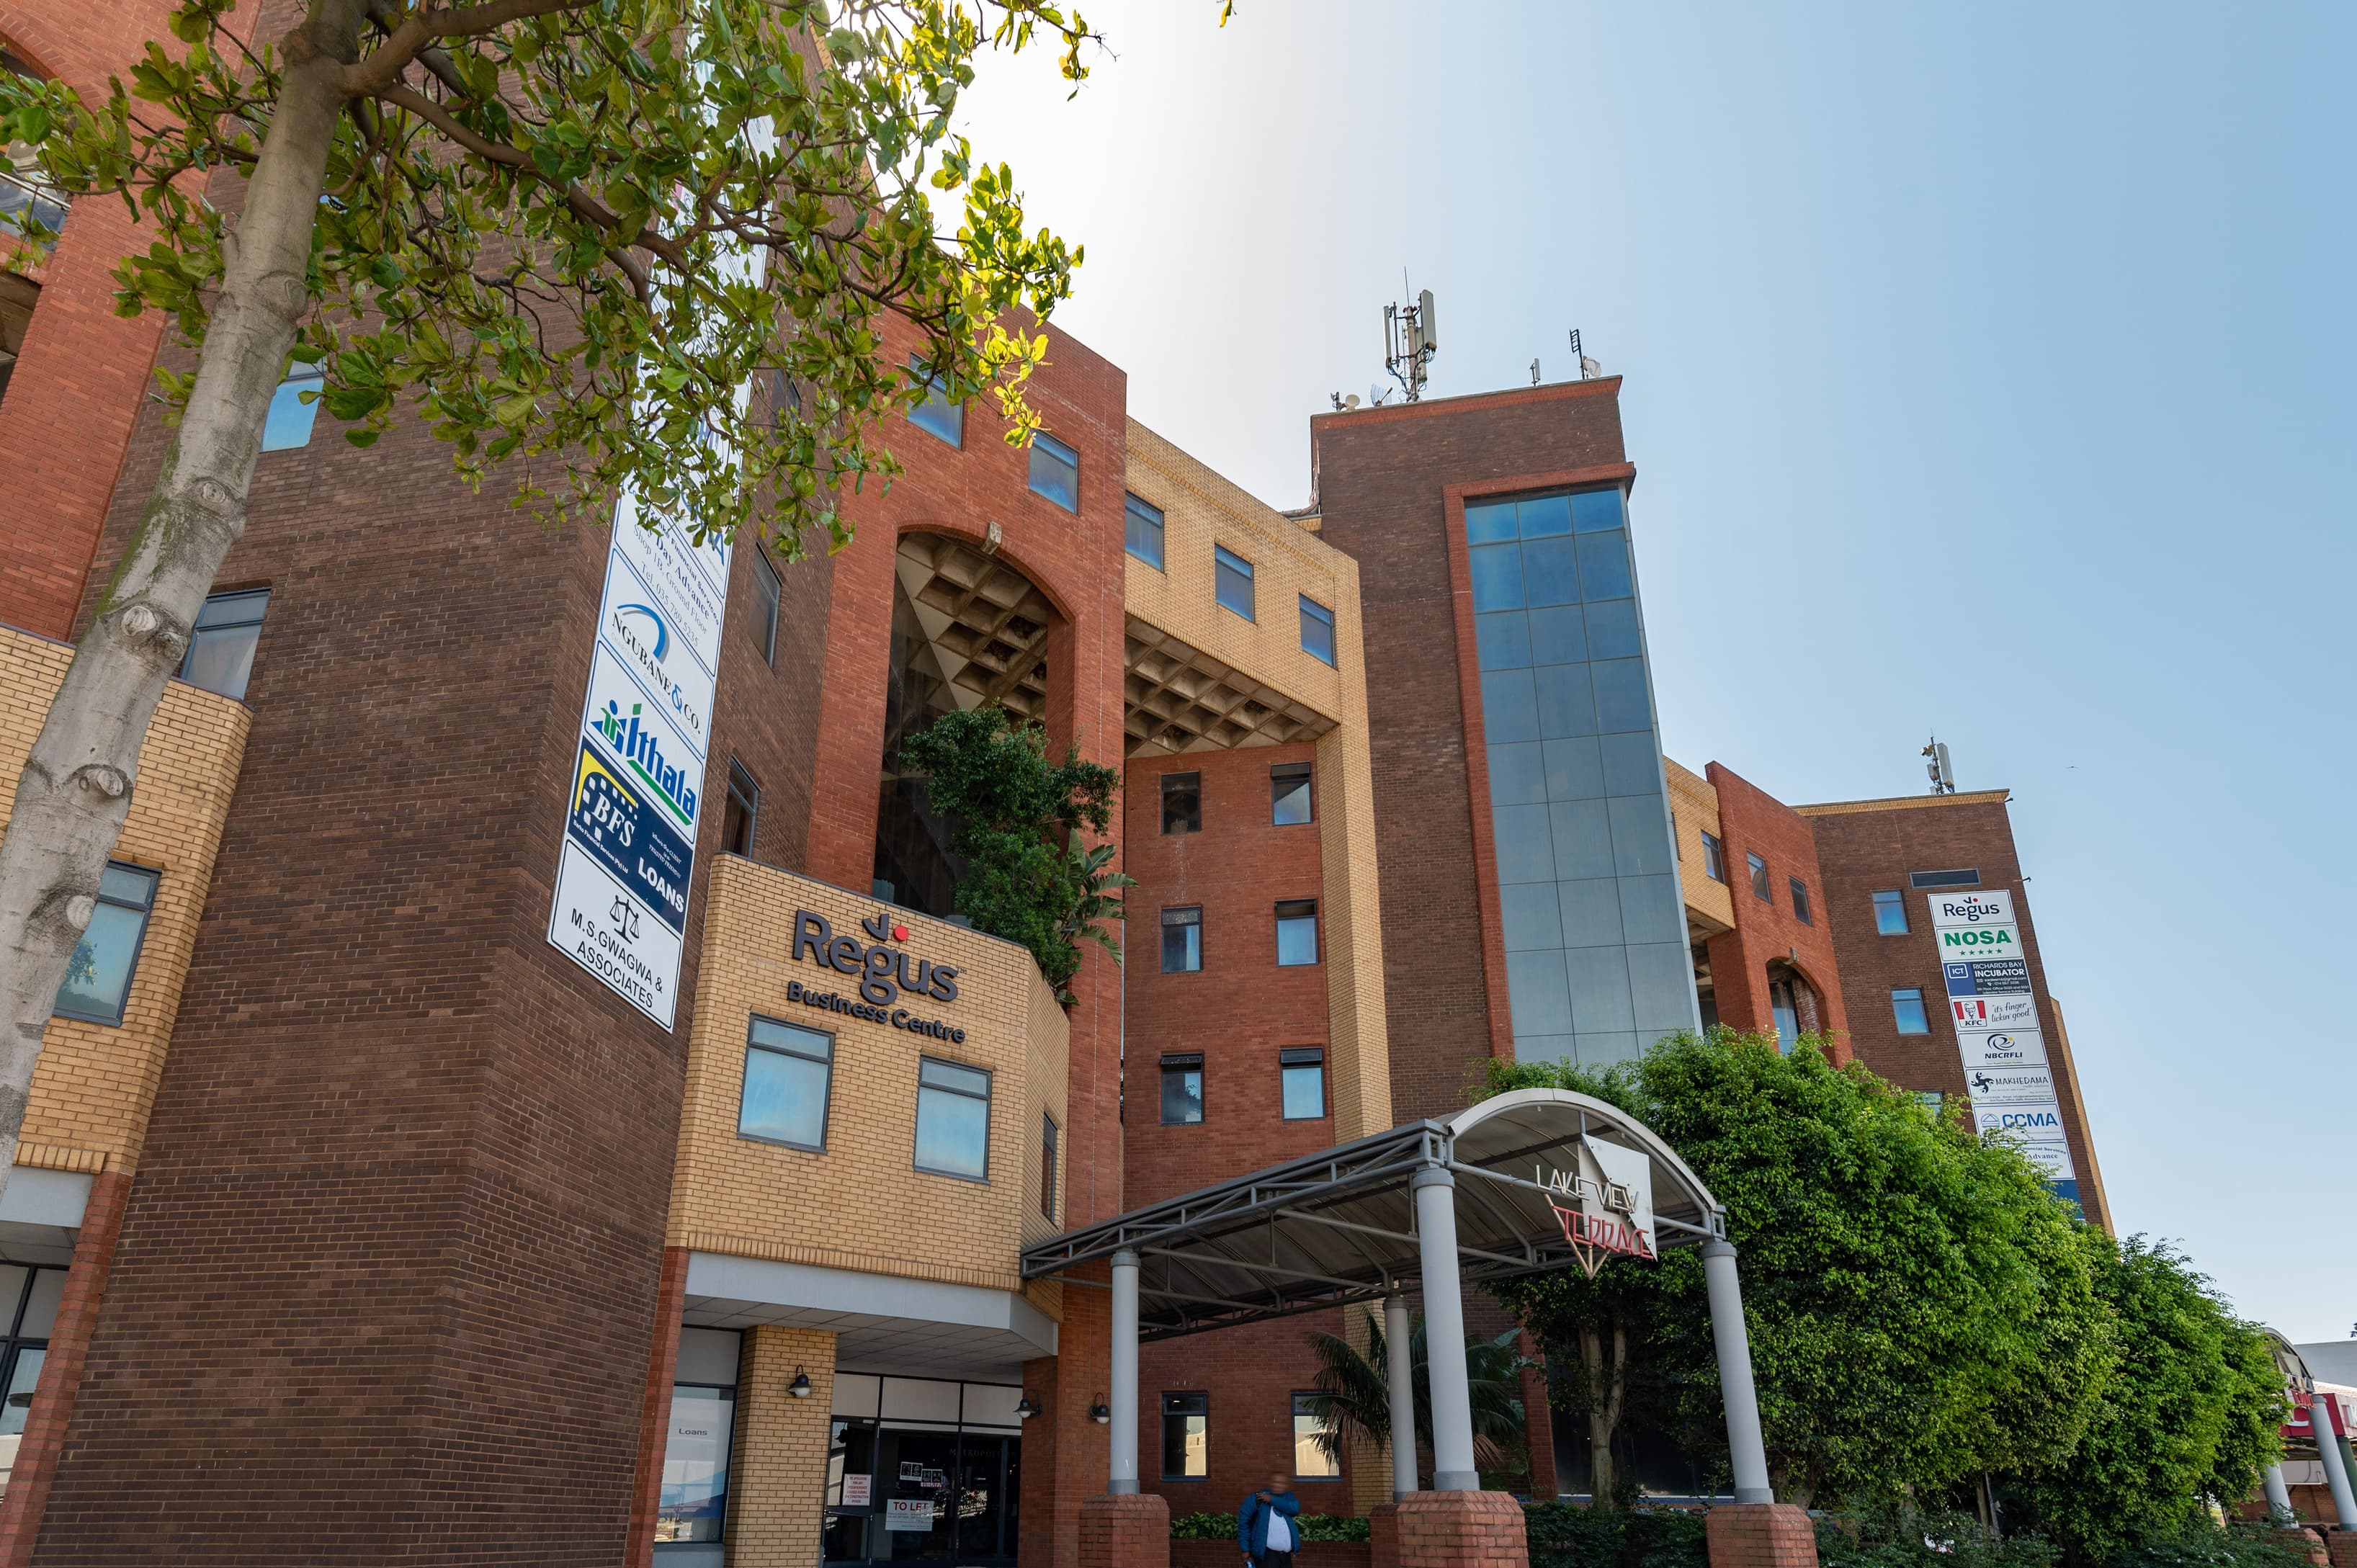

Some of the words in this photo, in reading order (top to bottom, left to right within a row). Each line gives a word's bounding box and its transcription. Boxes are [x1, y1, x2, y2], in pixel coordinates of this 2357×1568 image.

[634, 524, 651, 555] Shop
[666, 572, 689, 611] Ground
[691, 606, 707, 635] Floor
[641, 560, 655, 587] Tel.
[656, 583, 669, 605] 035
[671, 602, 682, 624] 789
[682, 622, 698, 647] 5235
[656, 536, 673, 567] Day
[674, 566, 710, 620] Advance
[671, 538, 697, 582] Financial
[697, 581, 719, 626] Services
[612, 612, 671, 696] NGUBANE
[671, 684, 683, 714] &
[684, 704, 701, 735] CO.
[573, 820, 584, 833] Barko
[584, 830, 601, 847] Financial
[600, 844, 614, 861] Services
[591, 792, 635, 847] BFS
[649, 844, 665, 863] TRUSTED
[669, 851, 681, 864] CLIENT
[638, 857, 684, 913] LOANS
[1943, 903, 2000, 921] Regus
[571, 908, 653, 986] M.S.GWAGWA
[655, 977, 663, 994] &
[792, 909, 959, 1005] Regus
[1944, 929, 2012, 946] NOSA
[577, 941, 653, 1008] ASSOCIATES
[1974, 969, 2025, 977] INCUBATOR
[787, 980, 888, 1023] Business
[891, 1009, 966, 1043] Centre
[2005, 1002, 2027, 1012] finger
[1995, 1077, 2049, 1085] MAKHEDAMA
[2002, 1113, 2059, 1129] CCMA
[1552, 1205, 1655, 1260] TERRACE
[893, 1502, 907, 1510] TO
[910, 1502, 928, 1511] LET
